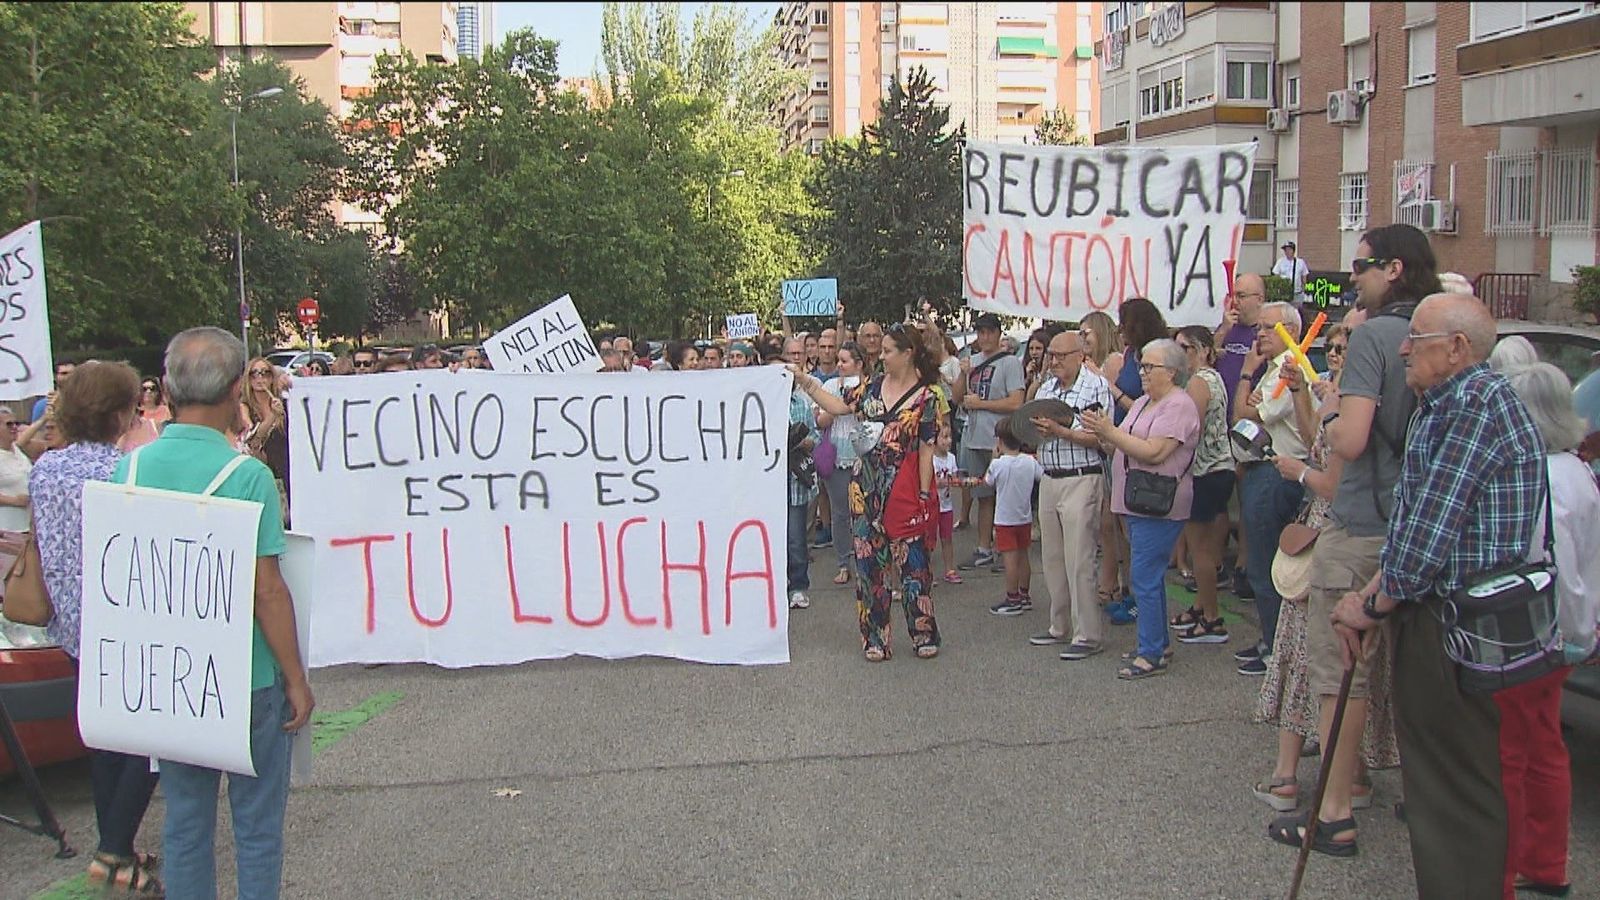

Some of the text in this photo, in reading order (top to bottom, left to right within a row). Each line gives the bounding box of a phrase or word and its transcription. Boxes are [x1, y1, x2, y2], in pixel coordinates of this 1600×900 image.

[965, 149, 1248, 219] REUBICAR
[785, 281, 813, 301] NO
[963, 215, 1152, 311] CANTÓN
[500, 311, 578, 362] NO AL
[728, 316, 757, 328] NO AL
[0, 333, 32, 384] S
[530, 391, 782, 472] ESCUCHA,
[405, 469, 661, 516] ESTA ES
[100, 533, 235, 624] CANTÓN
[329, 516, 778, 636] TU LUCHA
[98, 638, 225, 720] FUERA
